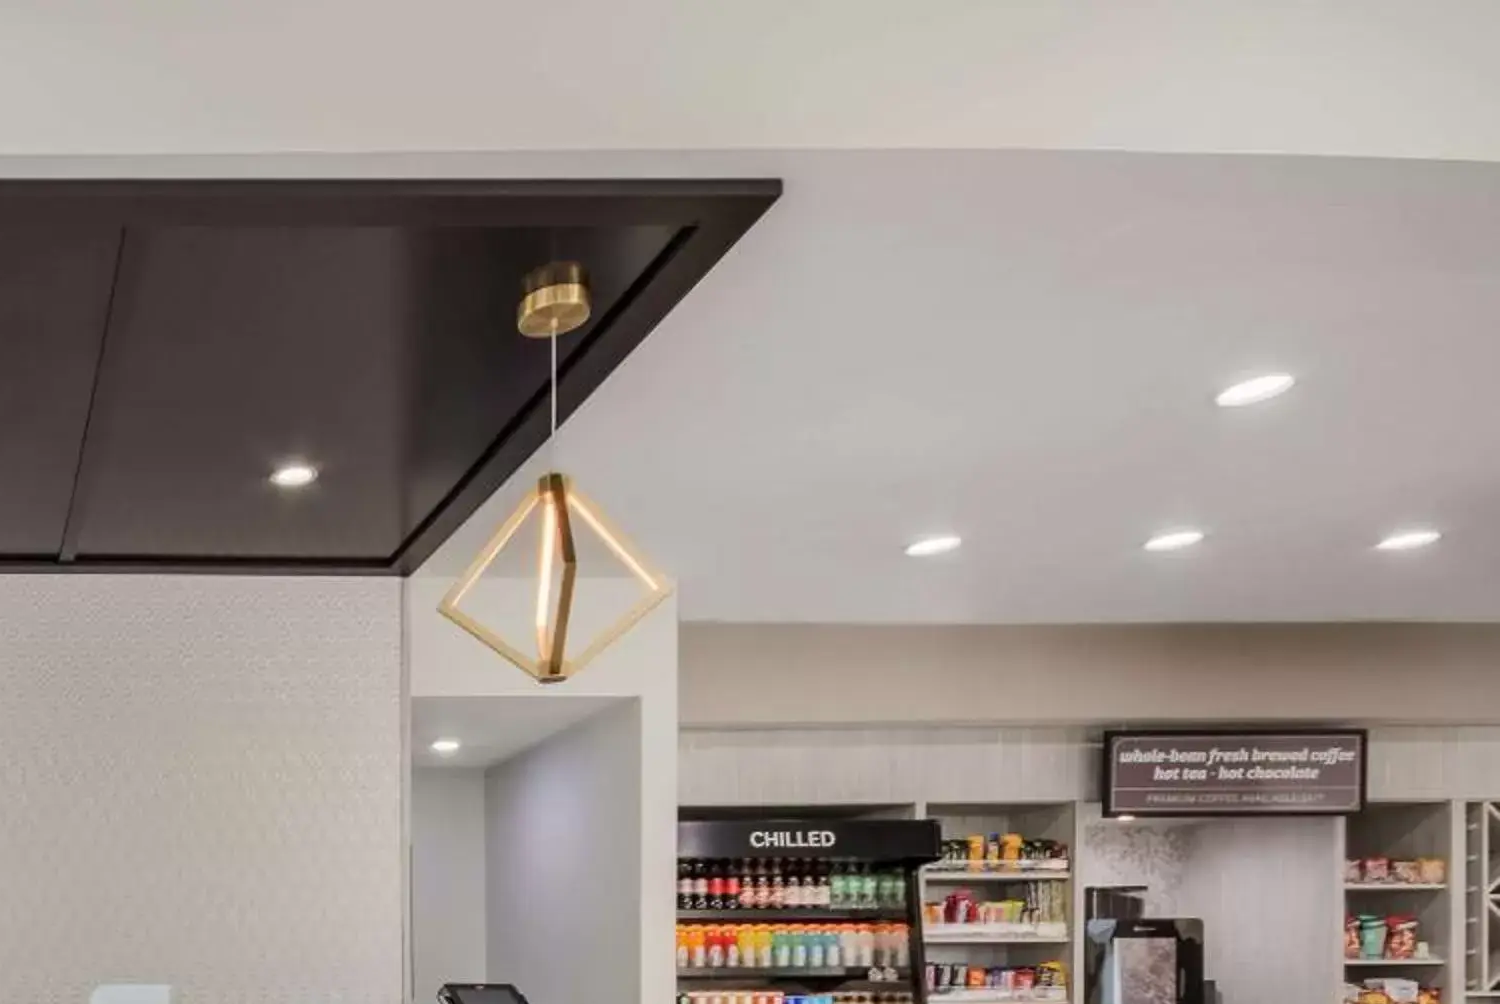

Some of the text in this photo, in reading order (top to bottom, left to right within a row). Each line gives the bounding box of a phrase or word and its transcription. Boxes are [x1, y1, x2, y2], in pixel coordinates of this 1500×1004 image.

[1119, 747, 1355, 766] whole-bean fresh brewed coffee
[1153, 766, 1180, 780] hot
[1182, 767, 1207, 780] tea
[1218, 766, 1244, 780] hot
[1246, 766, 1320, 780] chocolate
[749, 831, 836, 848] CHILLED
